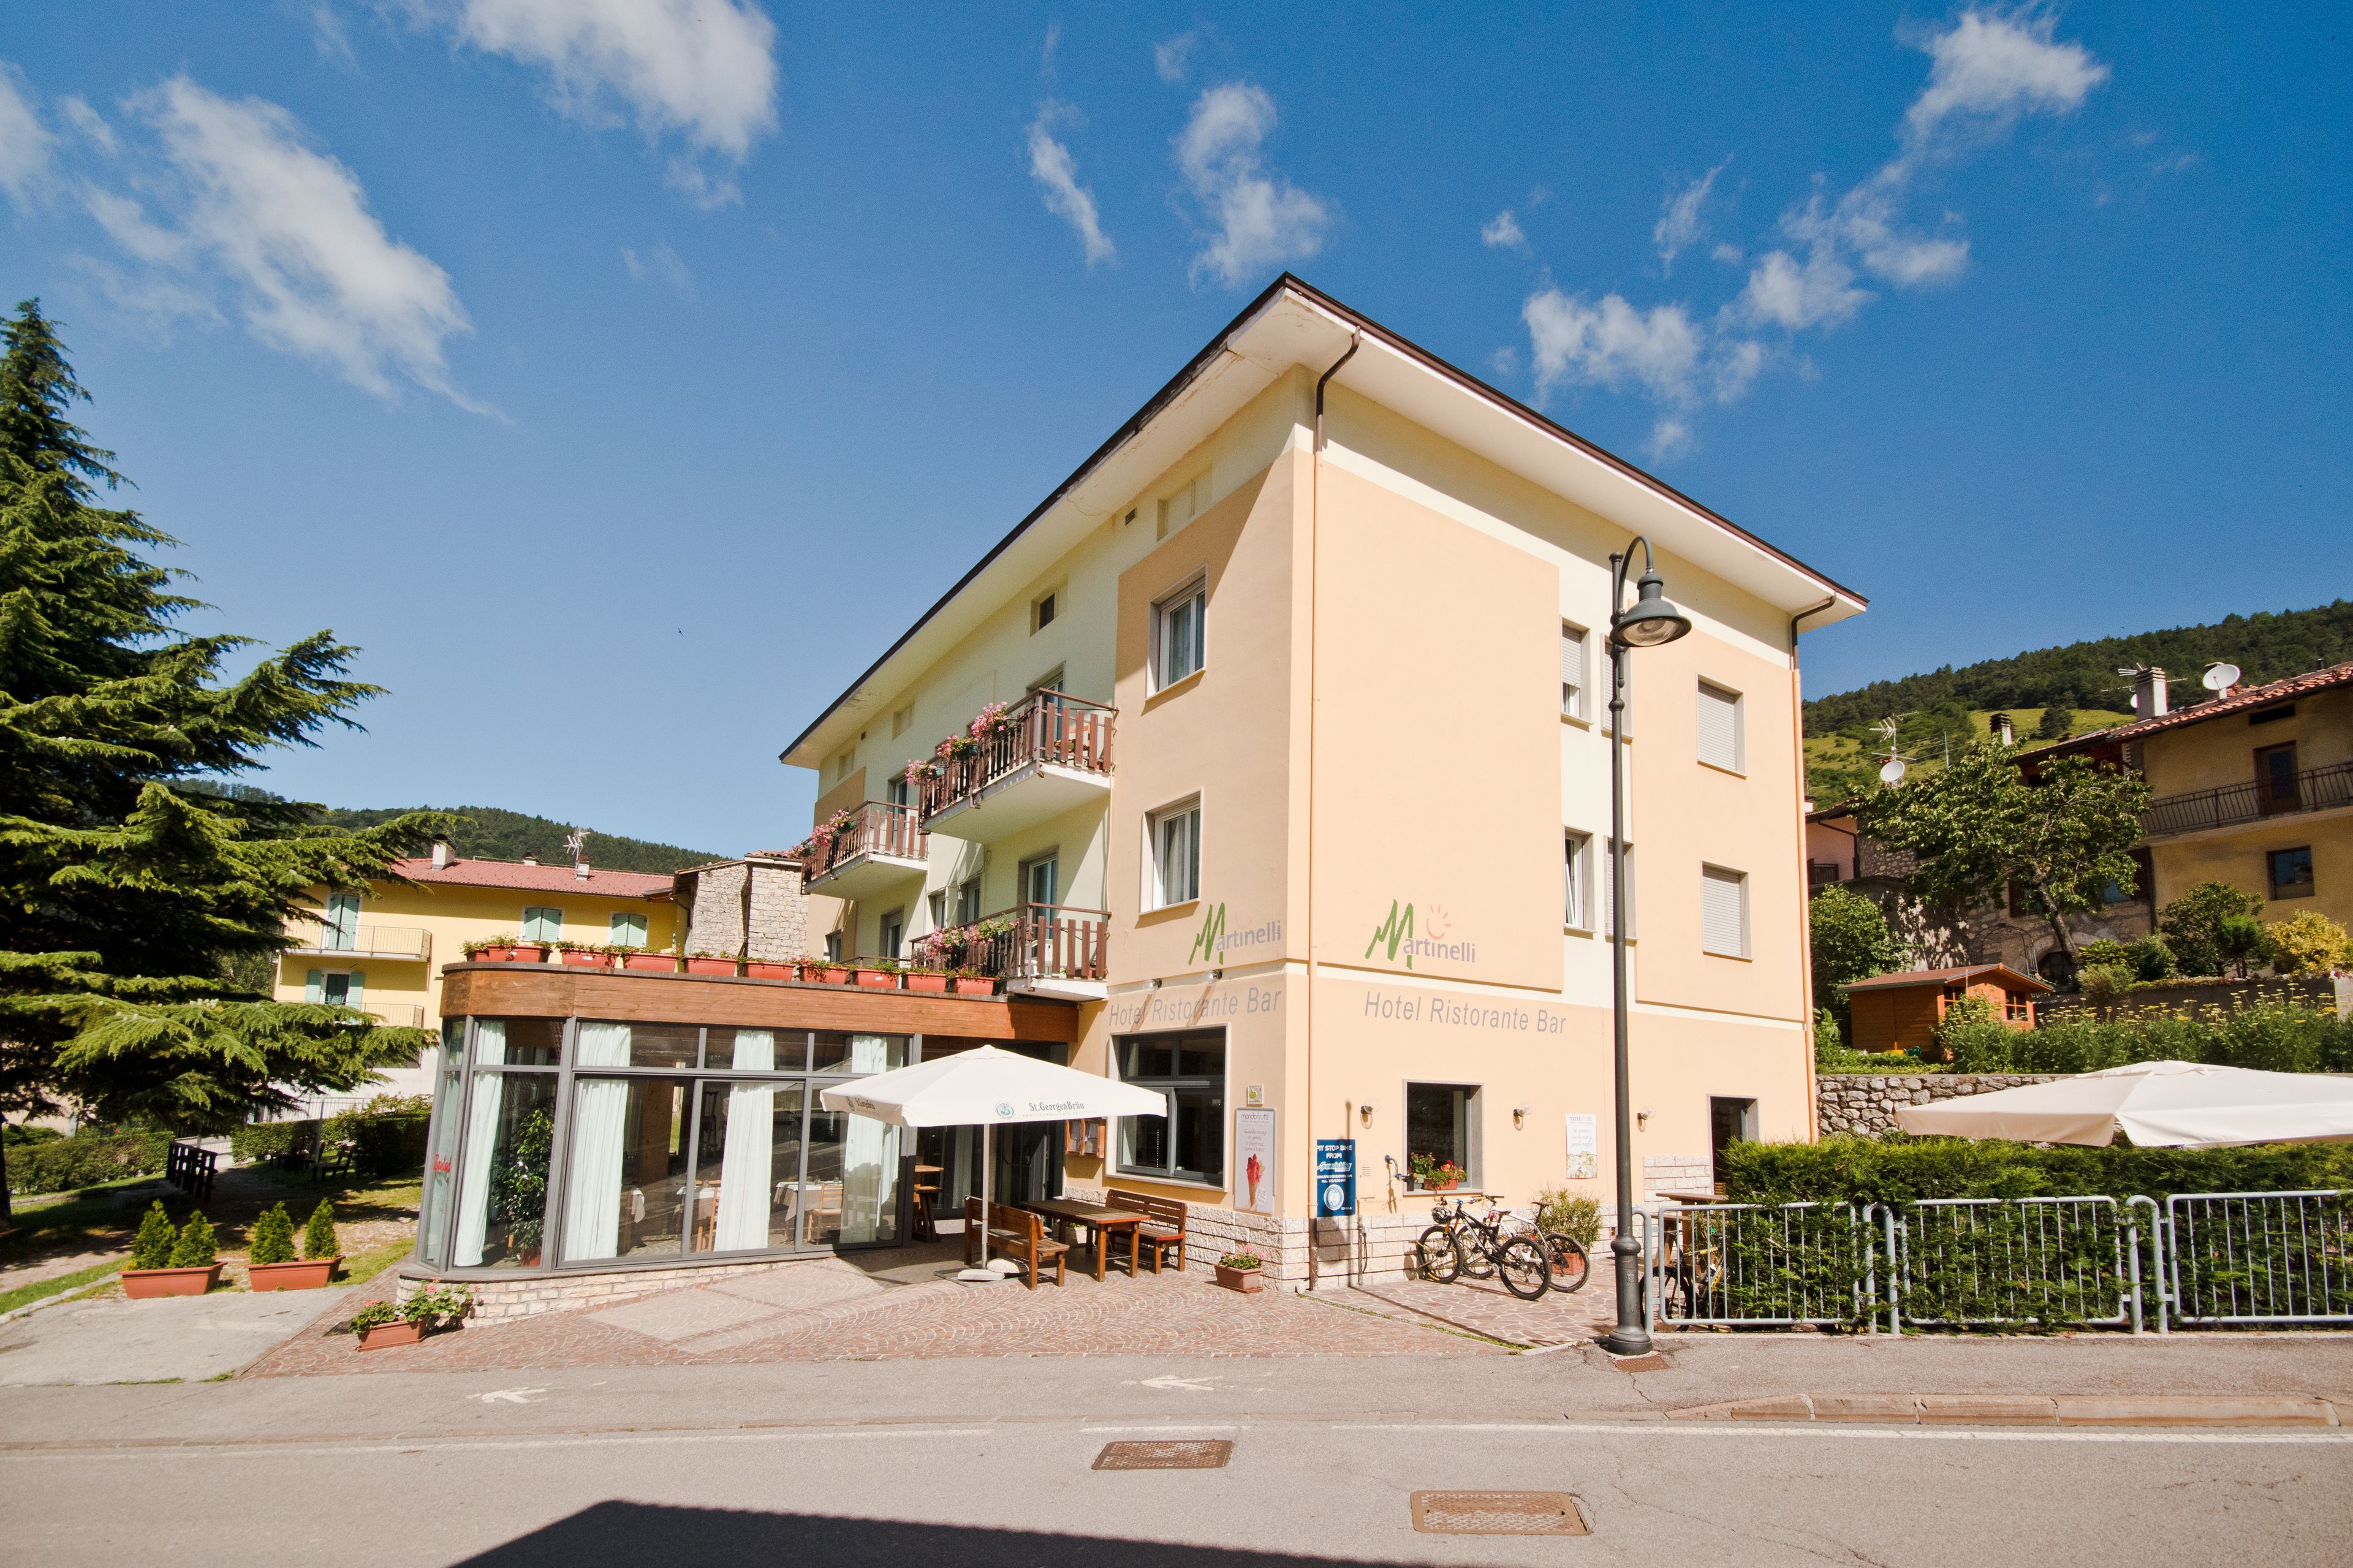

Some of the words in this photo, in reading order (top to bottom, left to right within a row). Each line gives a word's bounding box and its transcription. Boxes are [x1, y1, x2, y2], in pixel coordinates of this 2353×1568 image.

[1188, 903, 1281, 966] Martinelli
[1365, 898, 1476, 970] Martinelli
[1109, 1001, 1146, 1026] Hotel
[1151, 992, 1238, 1022] Ristorante
[1246, 986, 1282, 1013] Bar
[1364, 991, 1422, 1021] Hotel
[1430, 998, 1529, 1029] Ristorante
[1536, 1009, 1567, 1034] Bar
